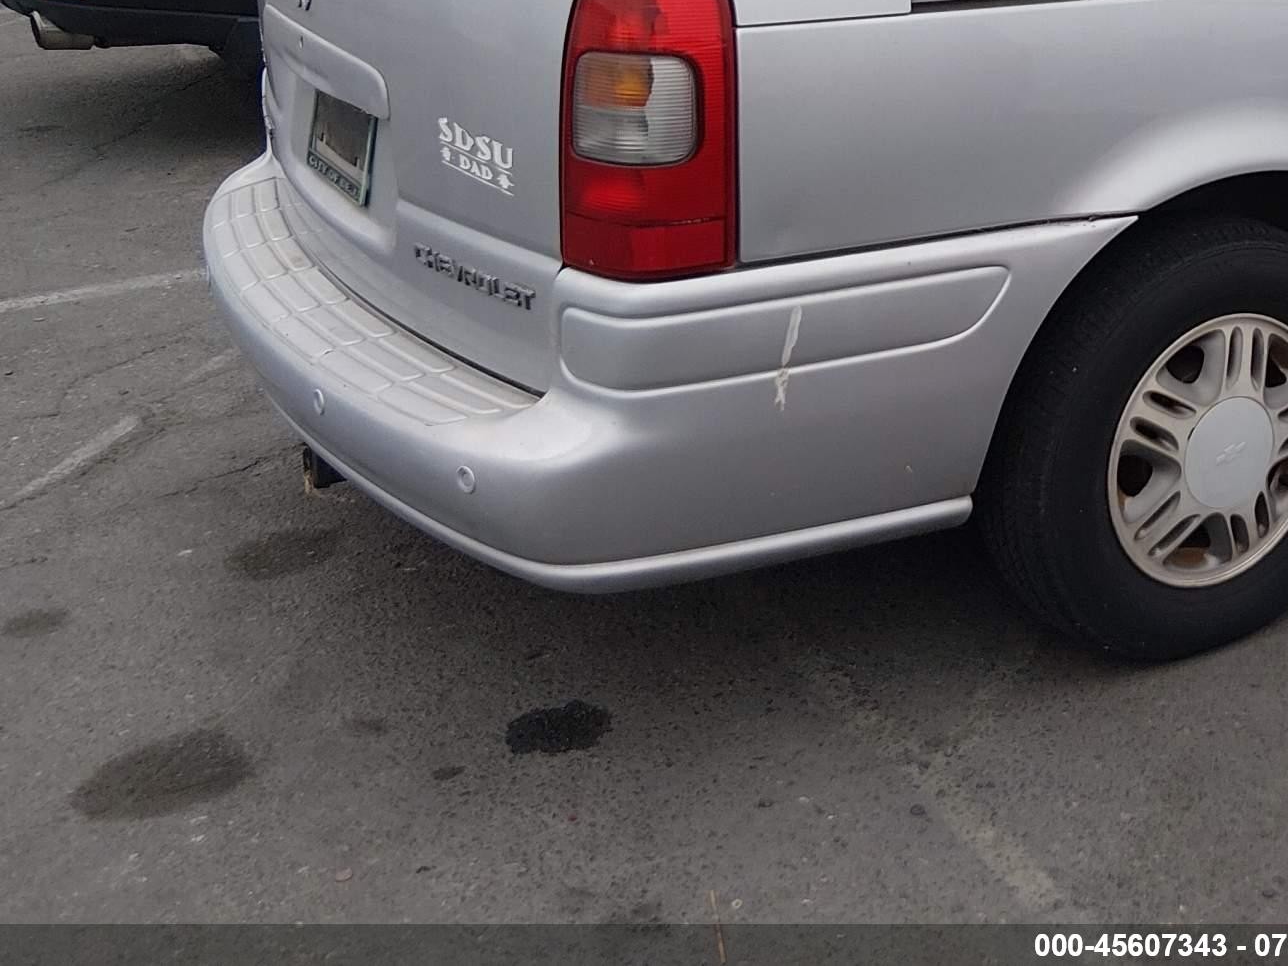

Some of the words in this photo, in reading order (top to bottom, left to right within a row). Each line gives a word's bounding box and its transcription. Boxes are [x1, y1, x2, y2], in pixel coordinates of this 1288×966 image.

[438, 117, 513, 169] SDSU
[459, 153, 493, 180] DAD
[414, 242, 536, 311] CHEVROLET
